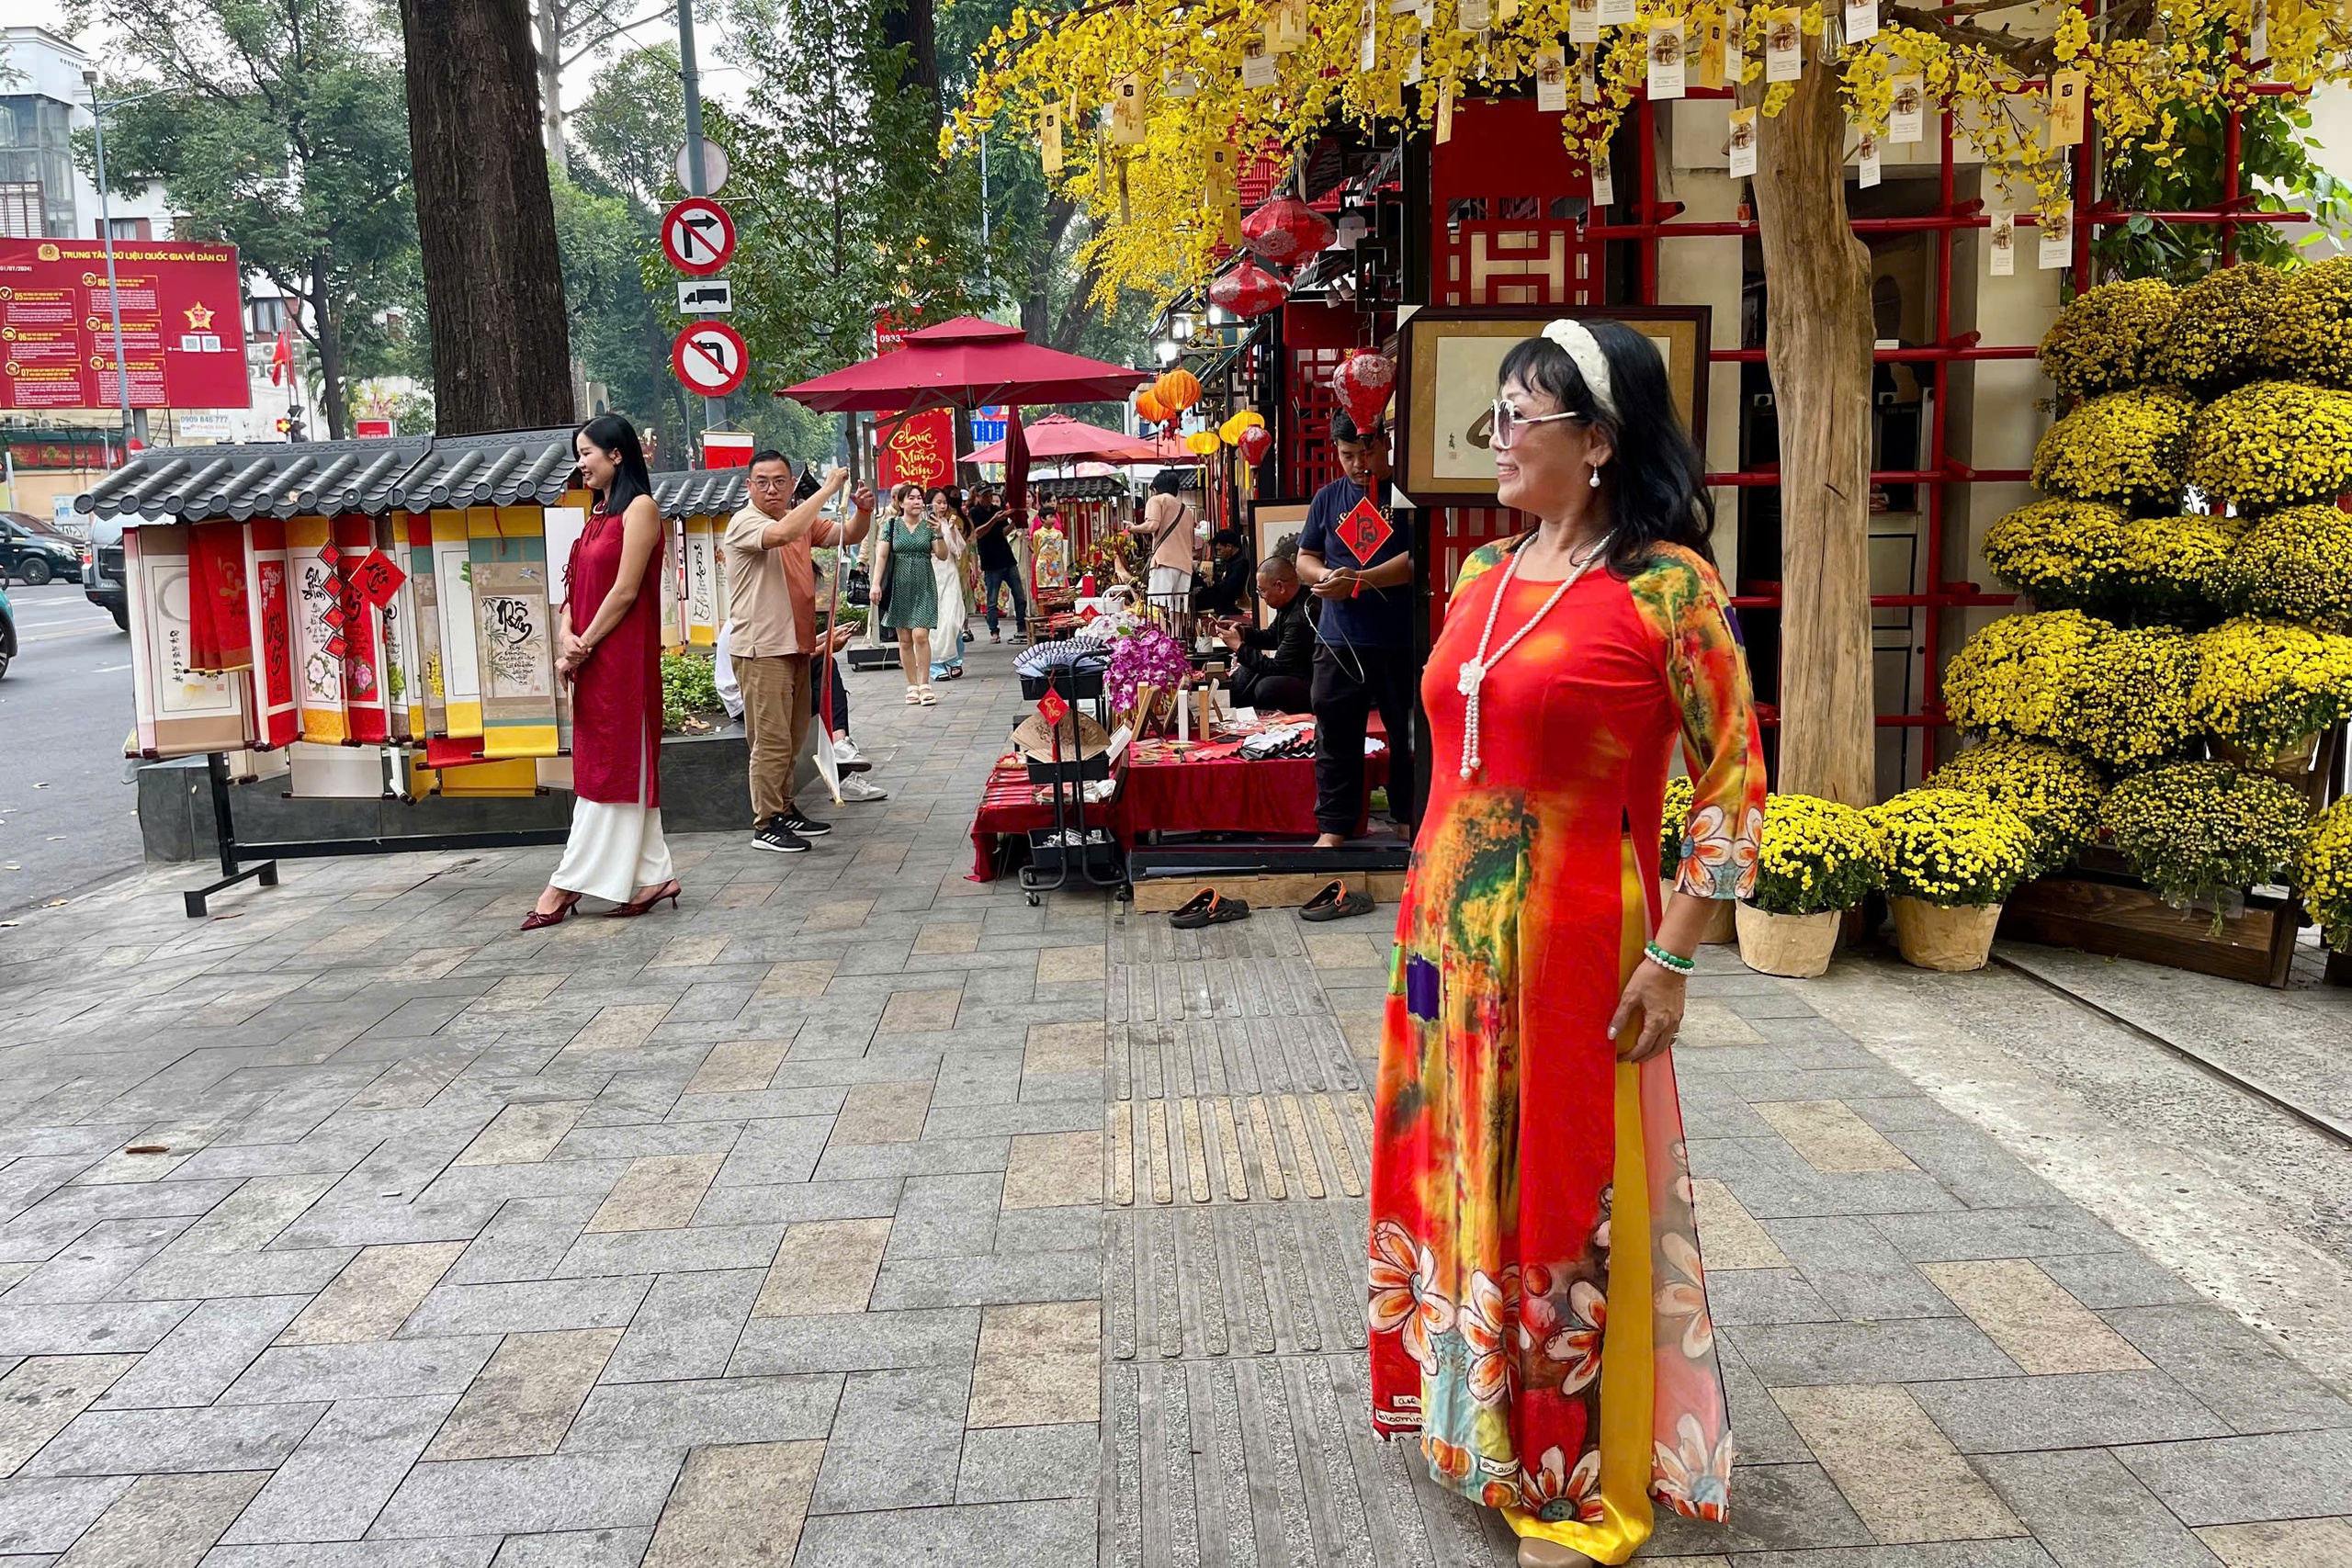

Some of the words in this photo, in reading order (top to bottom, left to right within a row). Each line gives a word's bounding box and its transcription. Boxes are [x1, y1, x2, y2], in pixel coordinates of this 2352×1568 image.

[62, 251, 91, 259] TRUNG
[125, 251, 143, 261] LIỆU
[144, 251, 168, 261] QUỐC
[168, 253, 184, 261] GIA
[15, 292, 23, 300] 05
[18, 333, 27, 341] 06
[889, 423, 937, 450] Chúc
[895, 461, 933, 479] Năm
[1398, 1397, 1418, 1405] are
